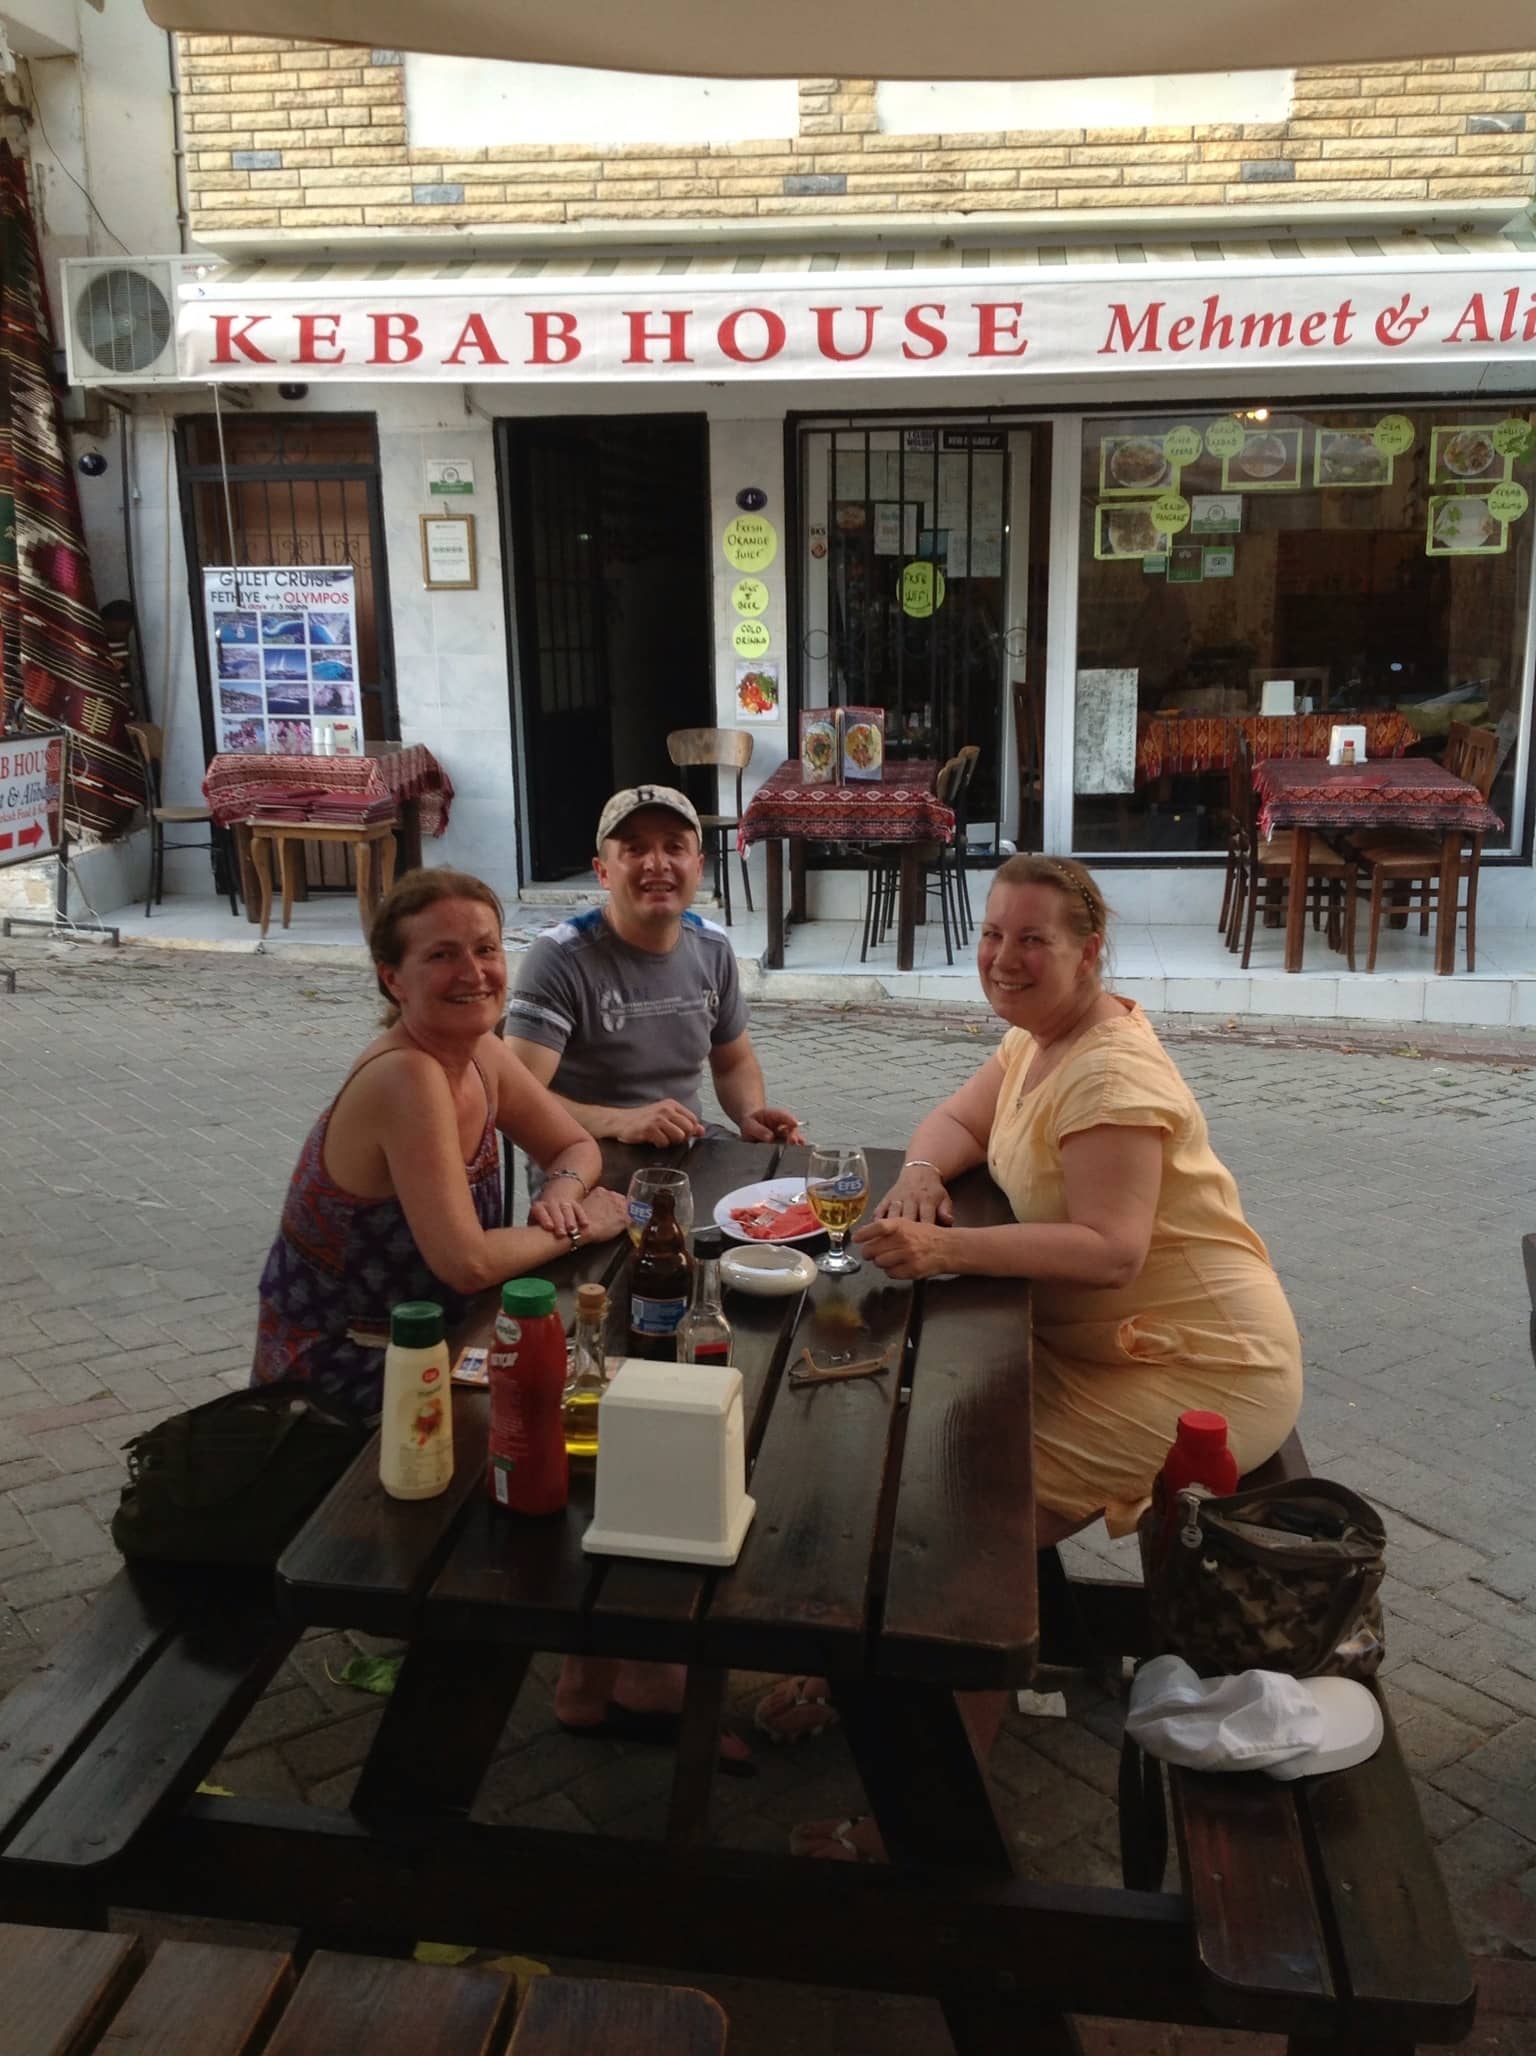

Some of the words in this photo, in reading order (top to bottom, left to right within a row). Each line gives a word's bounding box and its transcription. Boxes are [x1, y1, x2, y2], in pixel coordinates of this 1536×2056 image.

[1096, 293, 1357, 355] Mehmet
[1374, 292, 1430, 347] &
[207, 311, 583, 365] KEBAB
[621, 302, 1029, 365] HOUSE
[735, 519, 763, 533] FRESH
[727, 533, 769, 546] ORANGE
[735, 547, 766, 561] JUICE
[219, 571, 270, 587] GULET
[210, 591, 260, 603] FETHIYE
[283, 592, 350, 604] OLYMPOS
[740, 623, 763, 634] COLD
[837, 1179, 862, 1192] EFES
[630, 1203, 653, 1218] EFES
